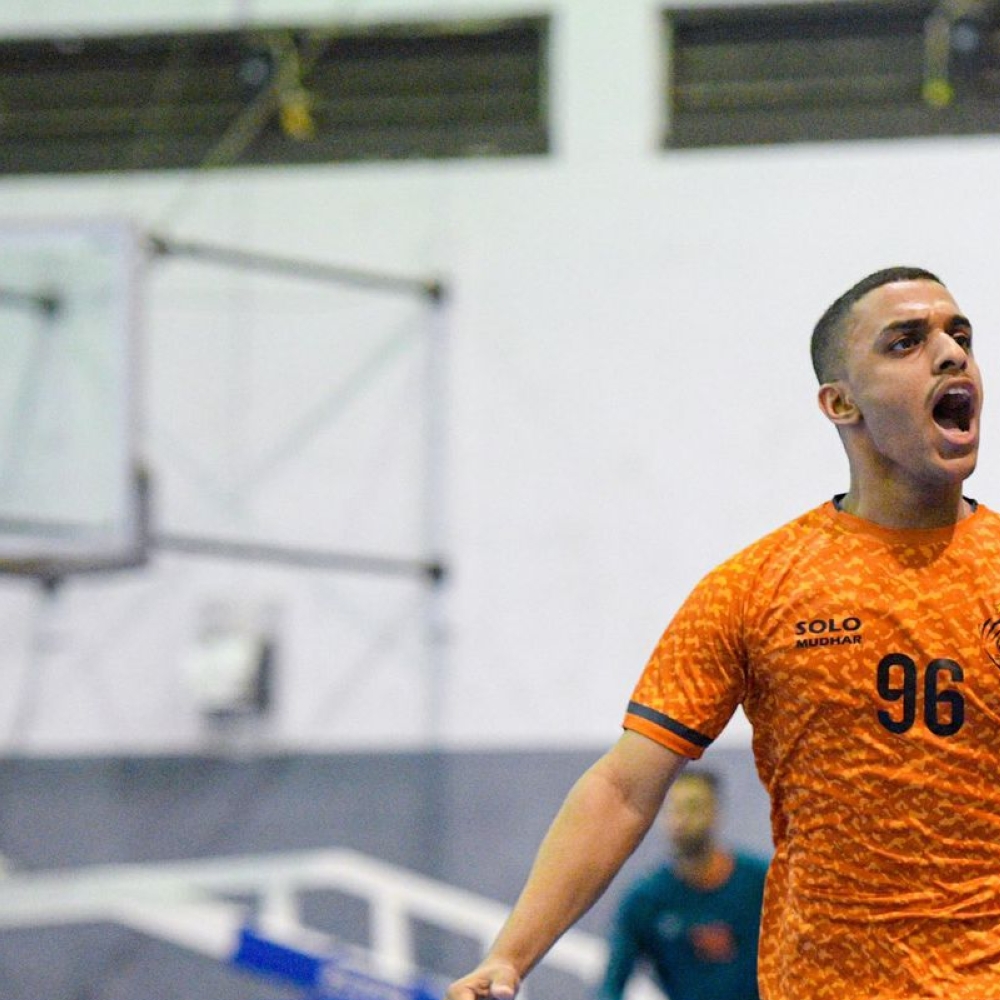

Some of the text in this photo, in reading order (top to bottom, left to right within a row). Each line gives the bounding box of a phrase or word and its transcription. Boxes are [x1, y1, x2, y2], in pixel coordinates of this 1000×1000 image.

[795, 617, 862, 635] SOLO
[796, 635, 862, 649] MUDHAR
[876, 653, 965, 736] 96
